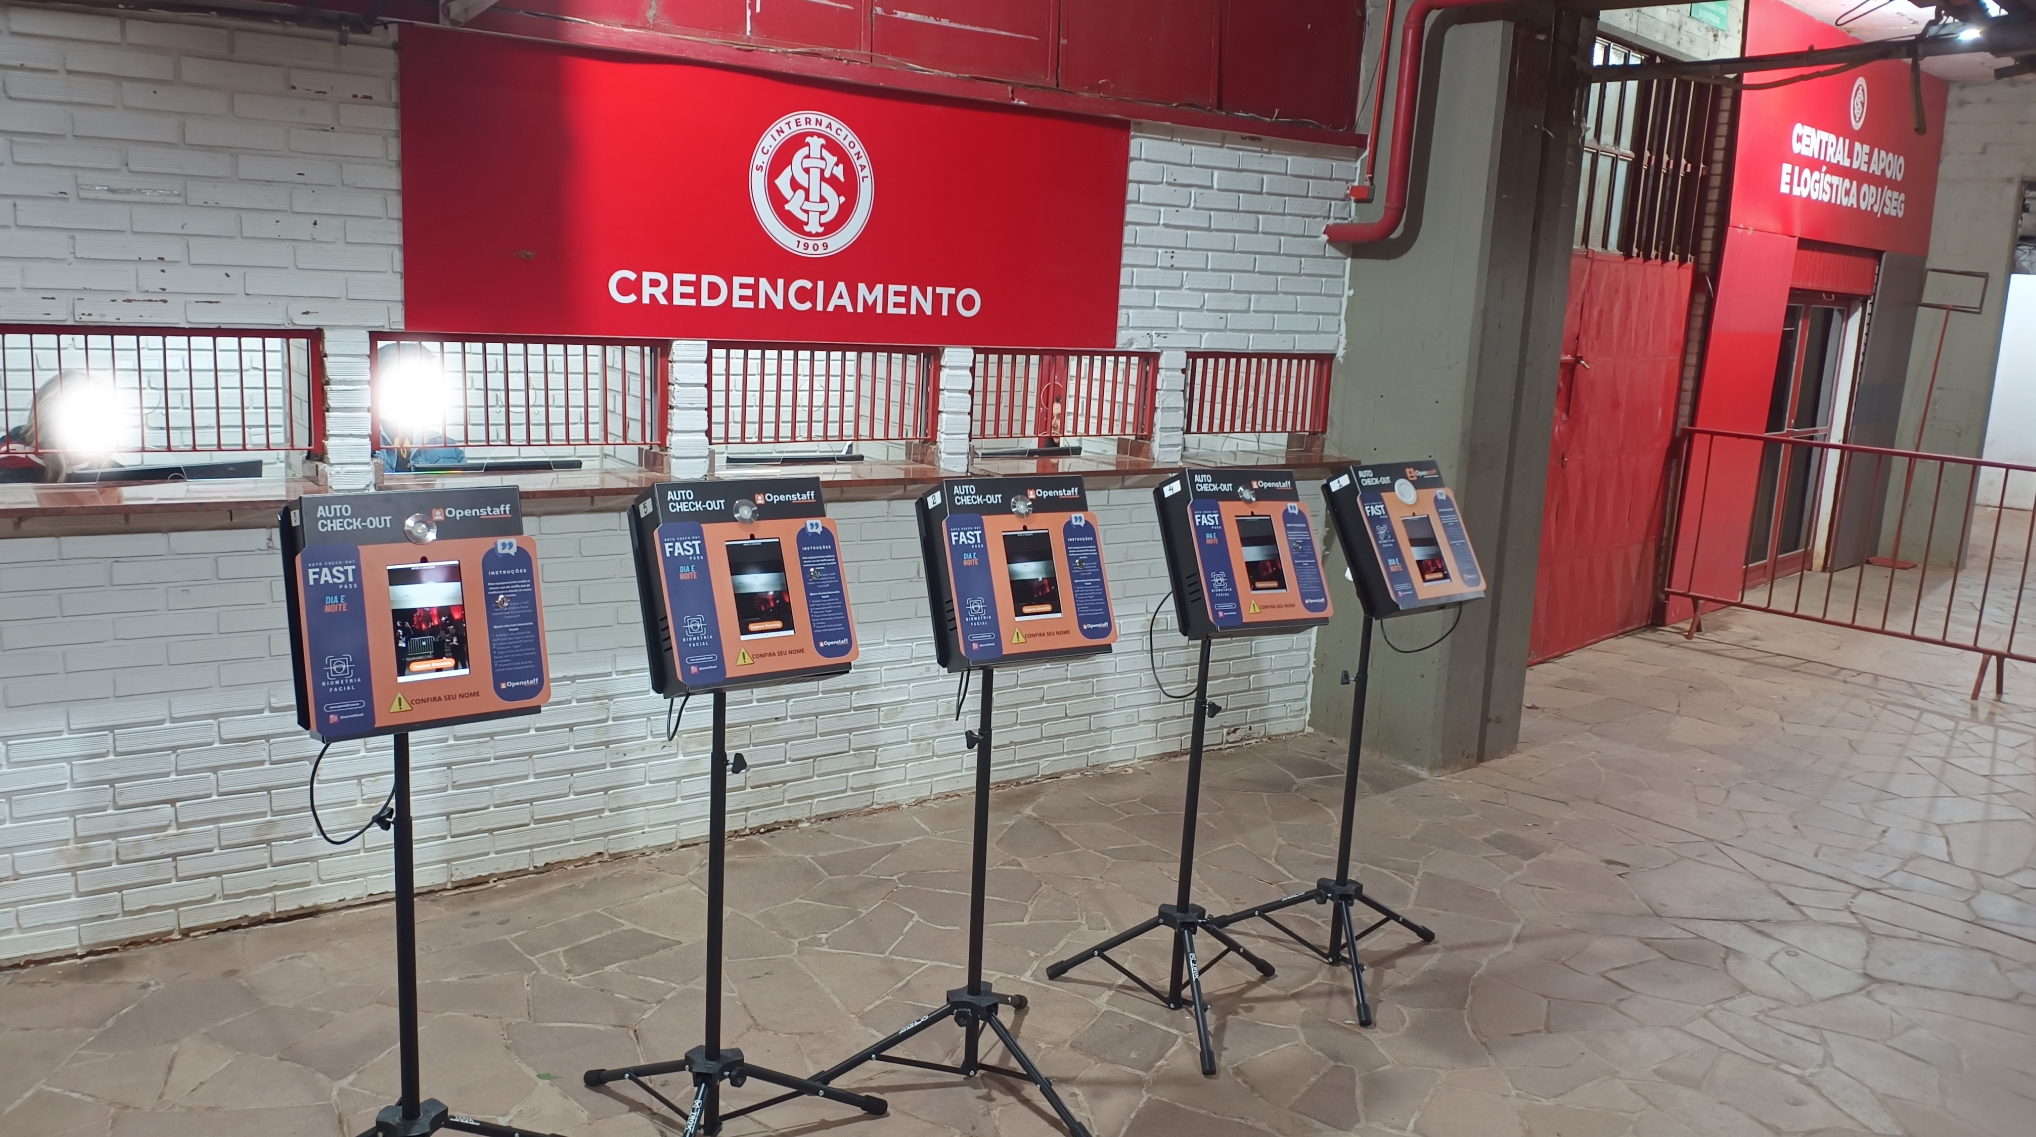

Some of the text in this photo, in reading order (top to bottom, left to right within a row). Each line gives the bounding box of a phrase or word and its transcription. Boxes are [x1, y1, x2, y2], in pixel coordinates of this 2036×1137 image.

[771, 116, 869, 183] INTERNACIONAL
[1791, 122, 1905, 181] CENTRAL DE APOIO
[1779, 162, 1906, 218] E LOGÍSTICA OPJ/SEG
[796, 239, 829, 251] 1909
[607, 269, 982, 317] CREDENCIAMENTO
[1194, 474, 1212, 483] AUTO
[1358, 469, 1374, 478] AUTO
[1258, 480, 1291, 490] Openstaff
[1361, 476, 1391, 486] CHECK-OUT
[953, 485, 976, 495] AUTO
[1035, 487, 1079, 499] Openstaff
[1196, 483, 1233, 492] CHECK-OUT
[667, 489, 694, 501] AUTO
[764, 490, 816, 504] Openstaff
[931, 494, 937, 505] 2
[954, 494, 1002, 506] CHECK-OUT
[316, 504, 352, 518] AUTO
[445, 504, 512, 520] Openstaff
[668, 499, 725, 513] CHECK-OUT
[1364, 504, 1386, 517] FAST
[318, 516, 392, 533] CHECK-OUT
[1194, 514, 1219, 526] FAST
[950, 530, 982, 545] FAST
[664, 540, 701, 557] FAST
[963, 552, 973, 560] DIA
[488, 568, 527, 576] INSTRUÇÕES
[679, 564, 695, 573] DIA E
[308, 565, 356, 586] FAST
[679, 571, 697, 580] NOITE
[325, 594, 346, 605] DIA E
[324, 603, 348, 613] NOITE
[823, 638, 848, 646] Openstaff
[752, 647, 805, 660] CONFIRA SEU NOME
[321, 677, 362, 687] BIOMETRIA
[506, 677, 539, 688] Openstaff
[329, 685, 356, 693] FACIAL
[410, 690, 480, 706] CONFIRA SEU NOME
